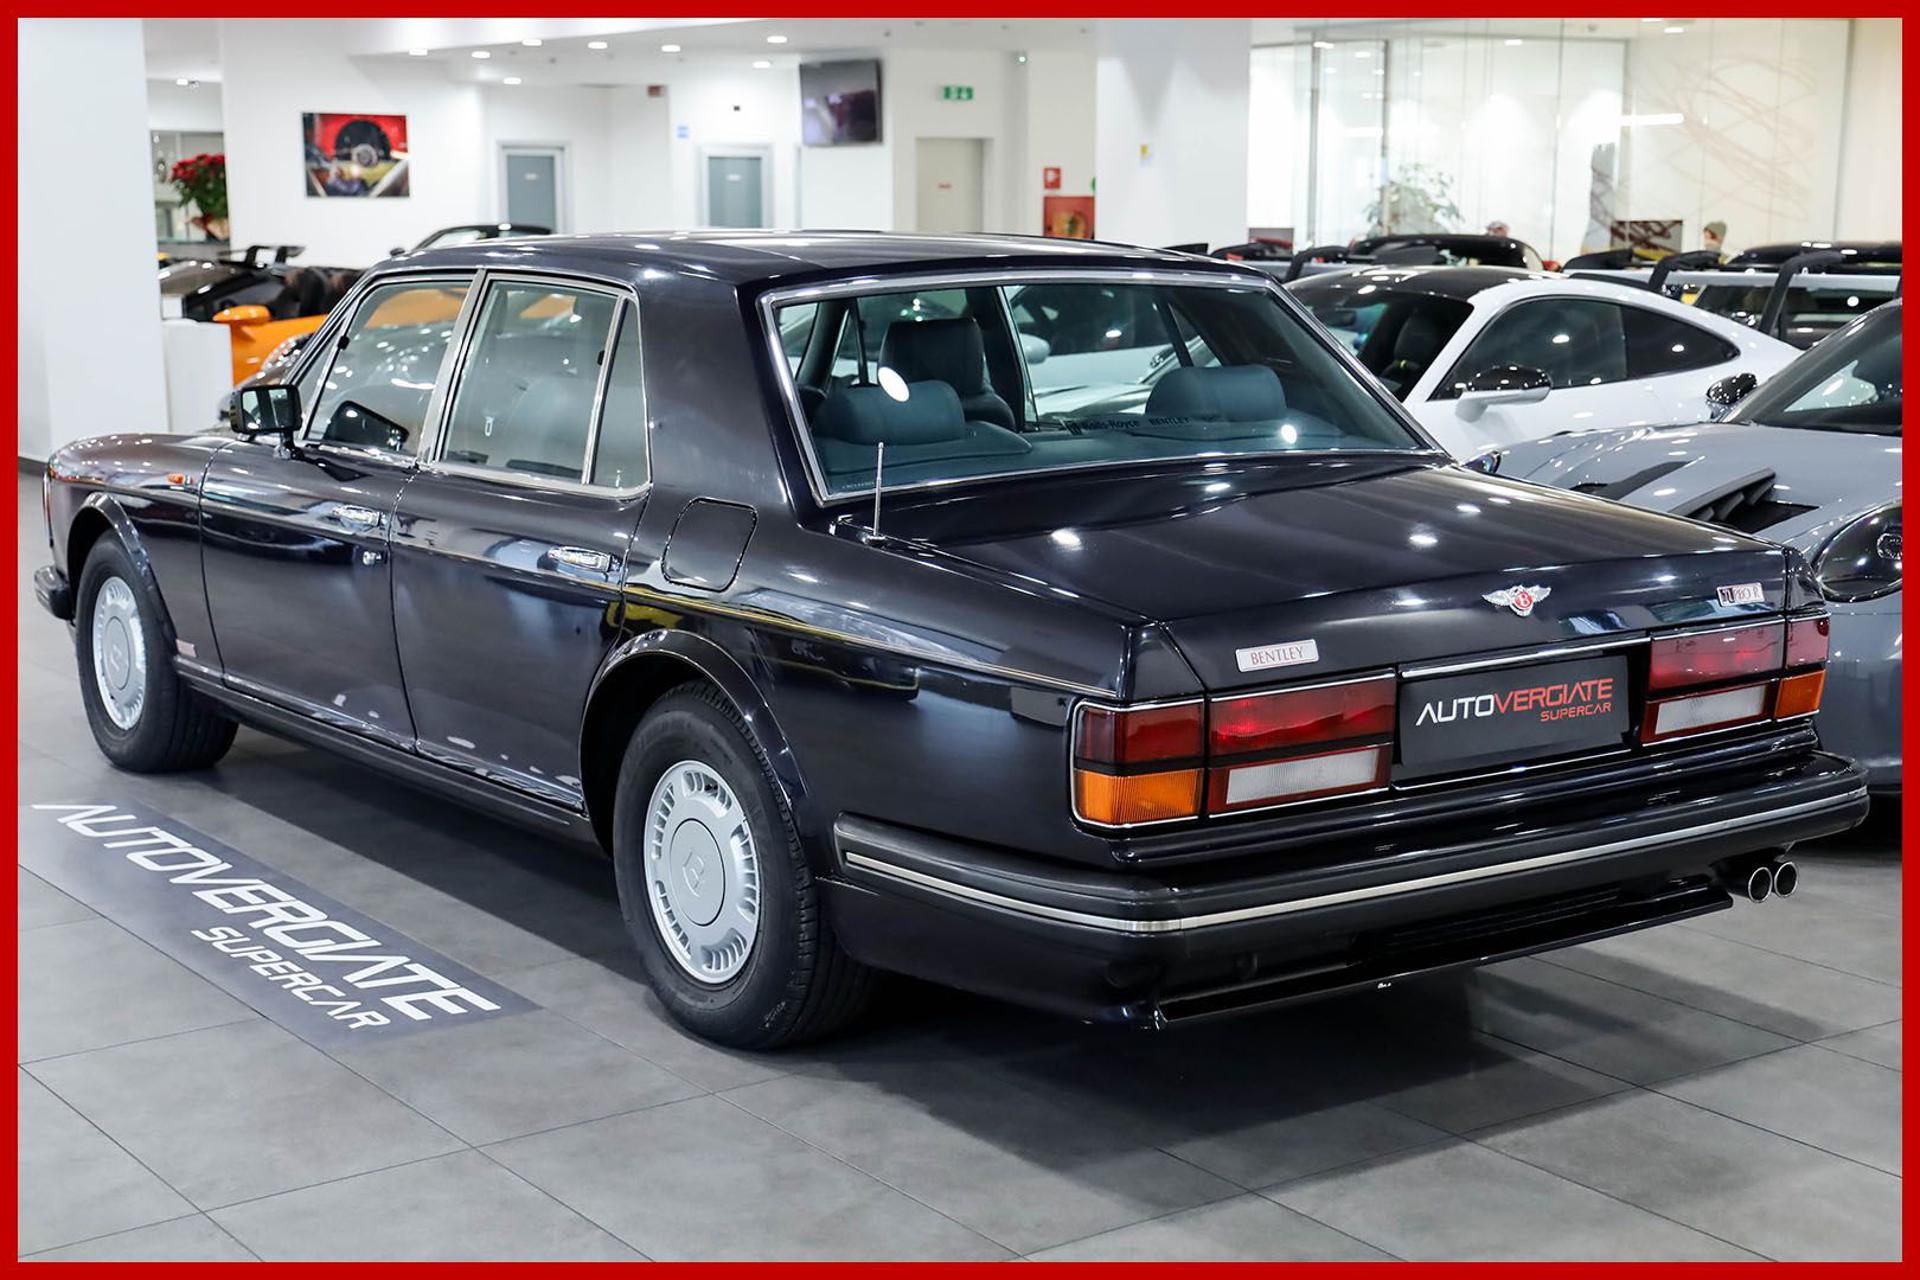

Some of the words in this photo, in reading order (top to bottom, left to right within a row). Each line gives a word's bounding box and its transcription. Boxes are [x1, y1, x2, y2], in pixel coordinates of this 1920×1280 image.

[1250, 646, 1303, 665] BENTLEY
[1415, 678, 1614, 727] AUTOVERGIATE
[1540, 702, 1612, 722] SUPERCAR
[31, 804, 501, 1022] AUTOVERGIATE
[190, 927, 392, 1031] SUPERCAR
